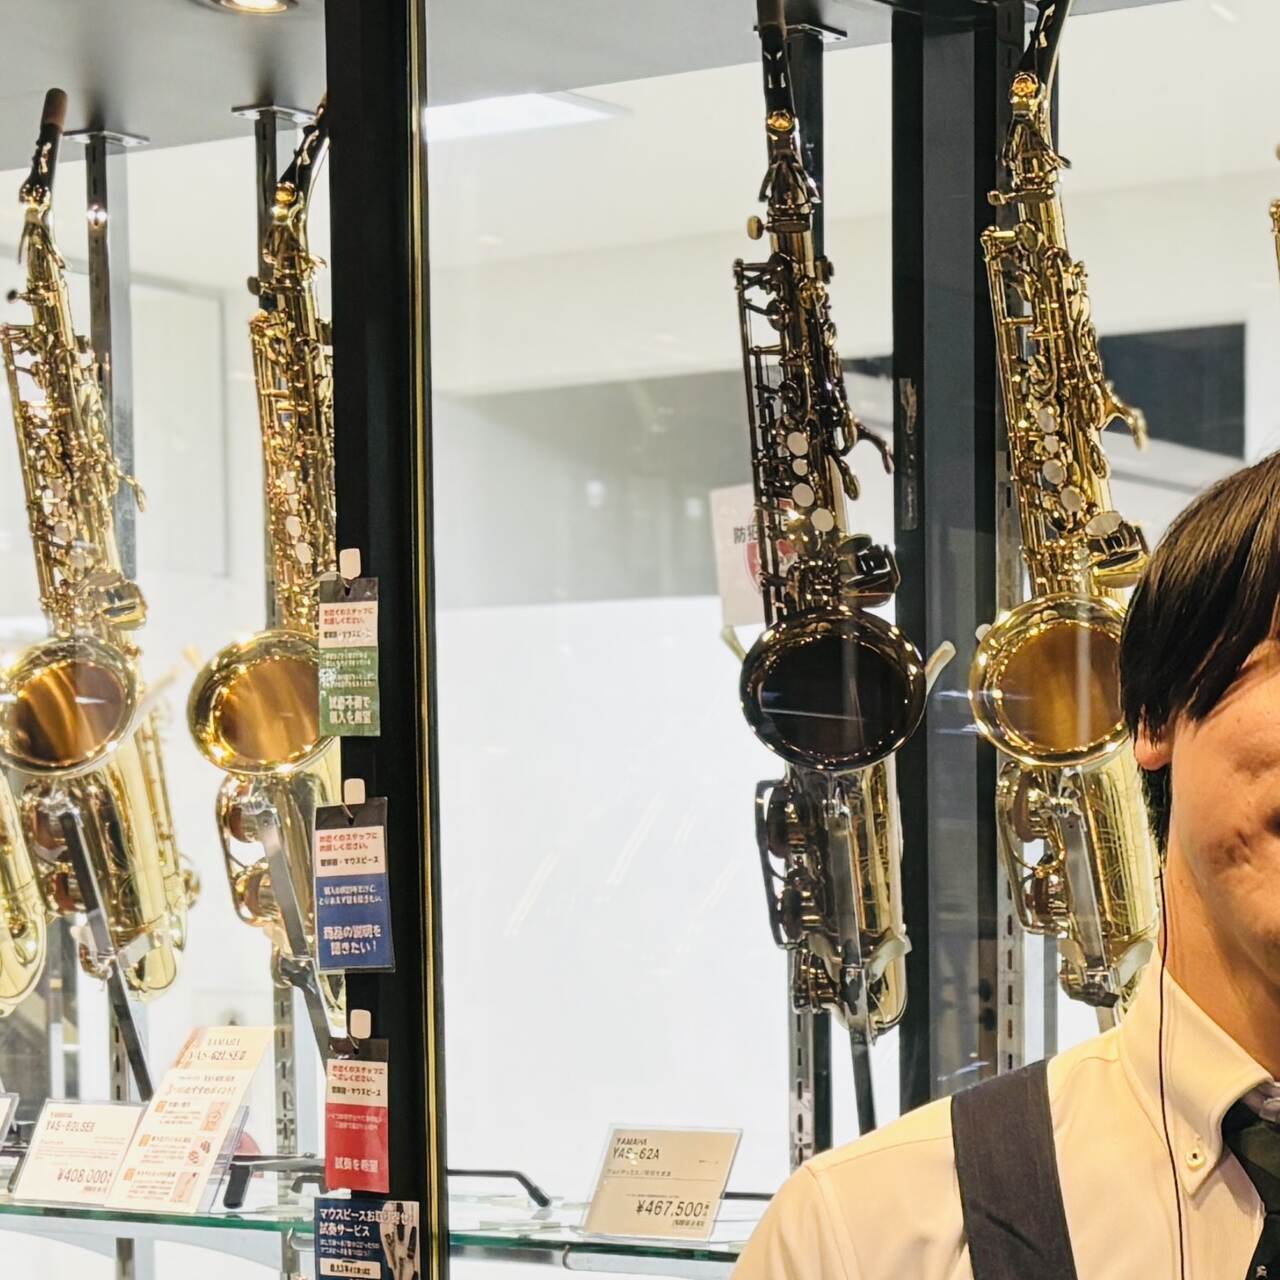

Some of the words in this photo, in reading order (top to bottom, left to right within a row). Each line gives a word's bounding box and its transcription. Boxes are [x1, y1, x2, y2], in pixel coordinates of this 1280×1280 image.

[323, 924, 382, 940] 商品の説明を
[616, 1137, 648, 1146] YAMAHA
[612, 1147, 660, 1161] YAS-62A
[635, 1199, 704, 1218] ¥467,500
